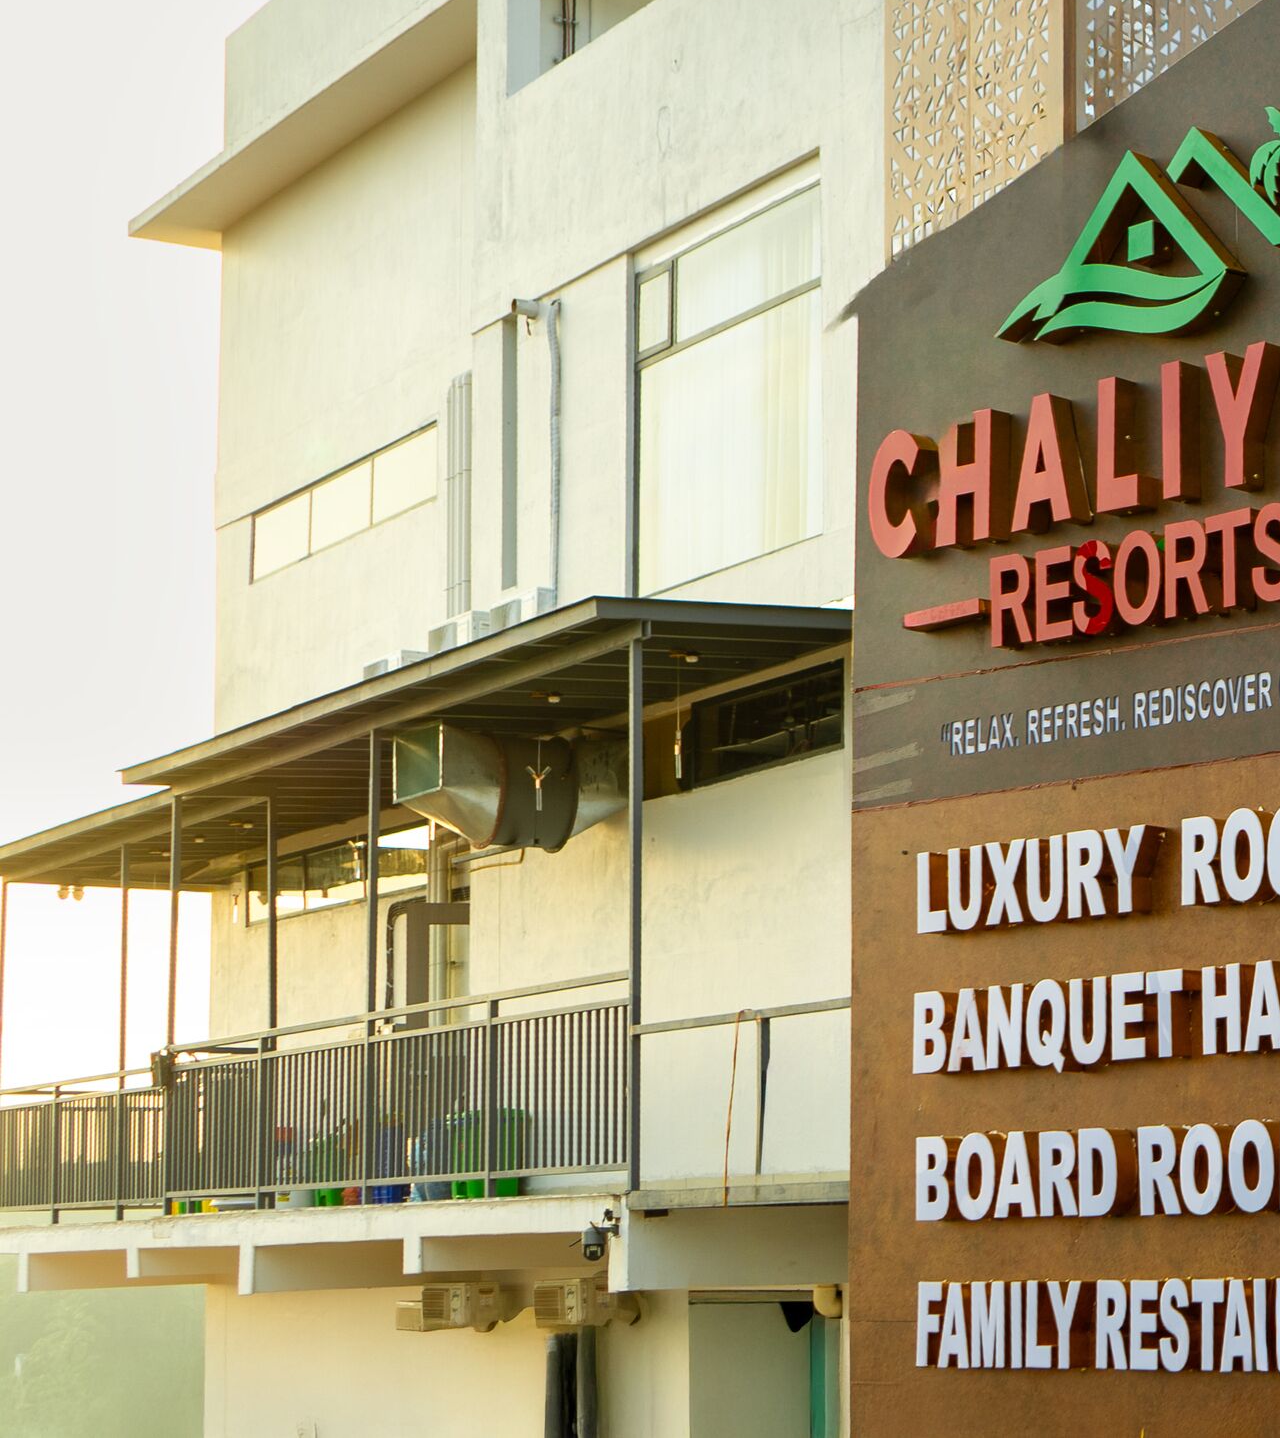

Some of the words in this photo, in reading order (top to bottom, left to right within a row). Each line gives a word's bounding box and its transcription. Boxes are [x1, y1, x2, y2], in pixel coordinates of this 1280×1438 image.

[1027, 696, 1126, 745] REFRESH.
[1133, 671, 1273, 730] REDISCOVER
[916, 824, 1148, 935] LUXURY
[913, 968, 1183, 1074] BANQUET
[915, 1127, 1118, 1222] BOARD
[915, 1279, 1082, 1370] FAMILY
